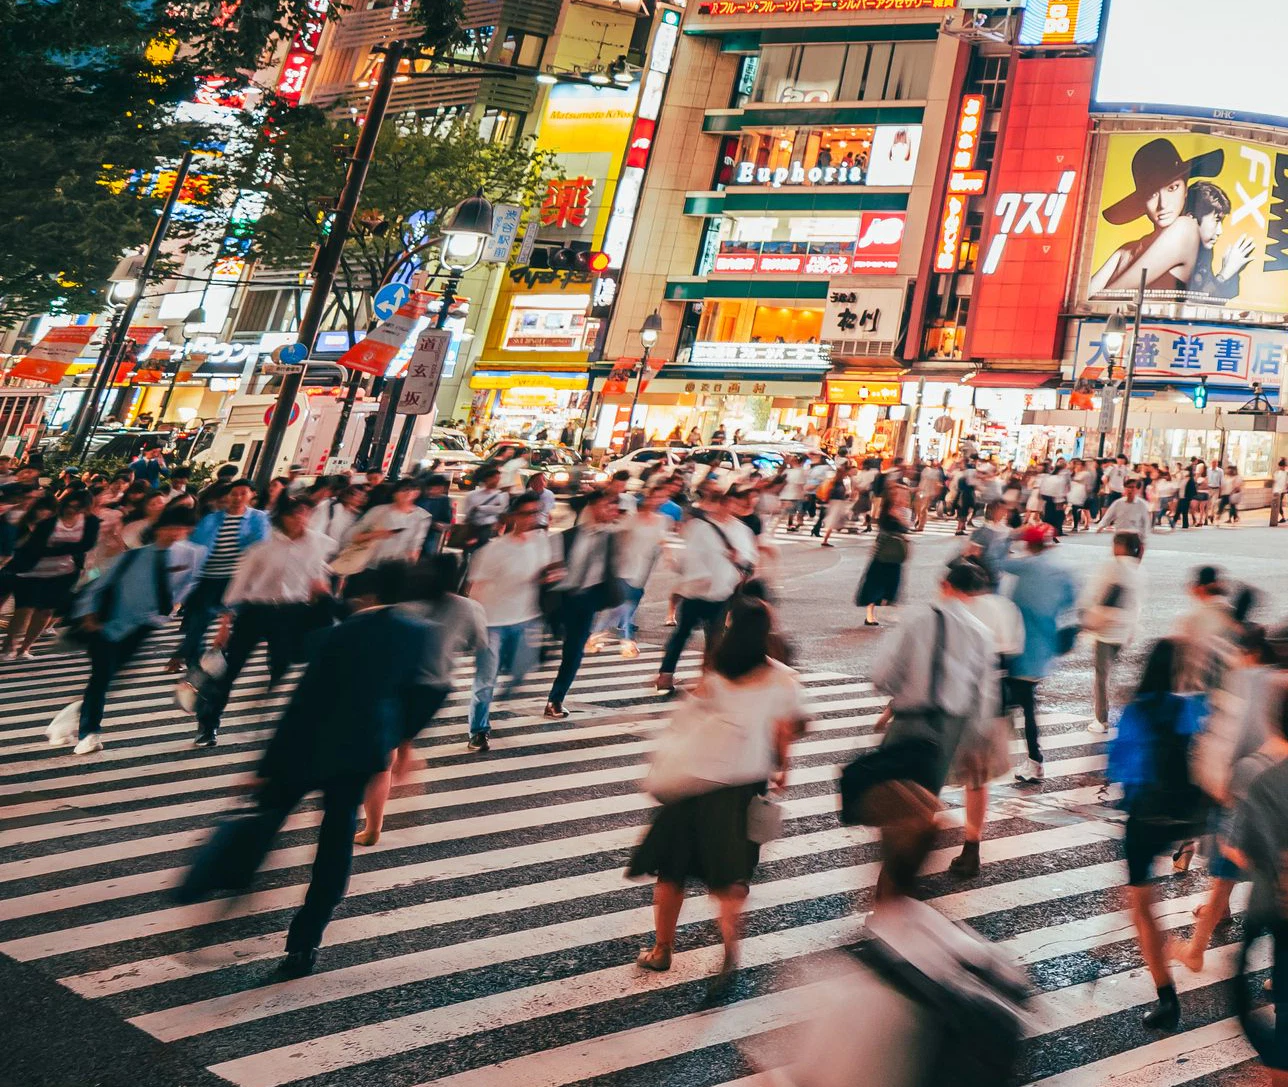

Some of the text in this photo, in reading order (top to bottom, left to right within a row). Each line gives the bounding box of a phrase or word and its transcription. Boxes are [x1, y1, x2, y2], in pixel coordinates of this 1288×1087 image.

[1213, 109, 1236, 119] DHC
[737, 160, 862, 188] Euphoria
[1230, 145, 1271, 230] FX
[400, 337, 436, 406] 道玄坂
